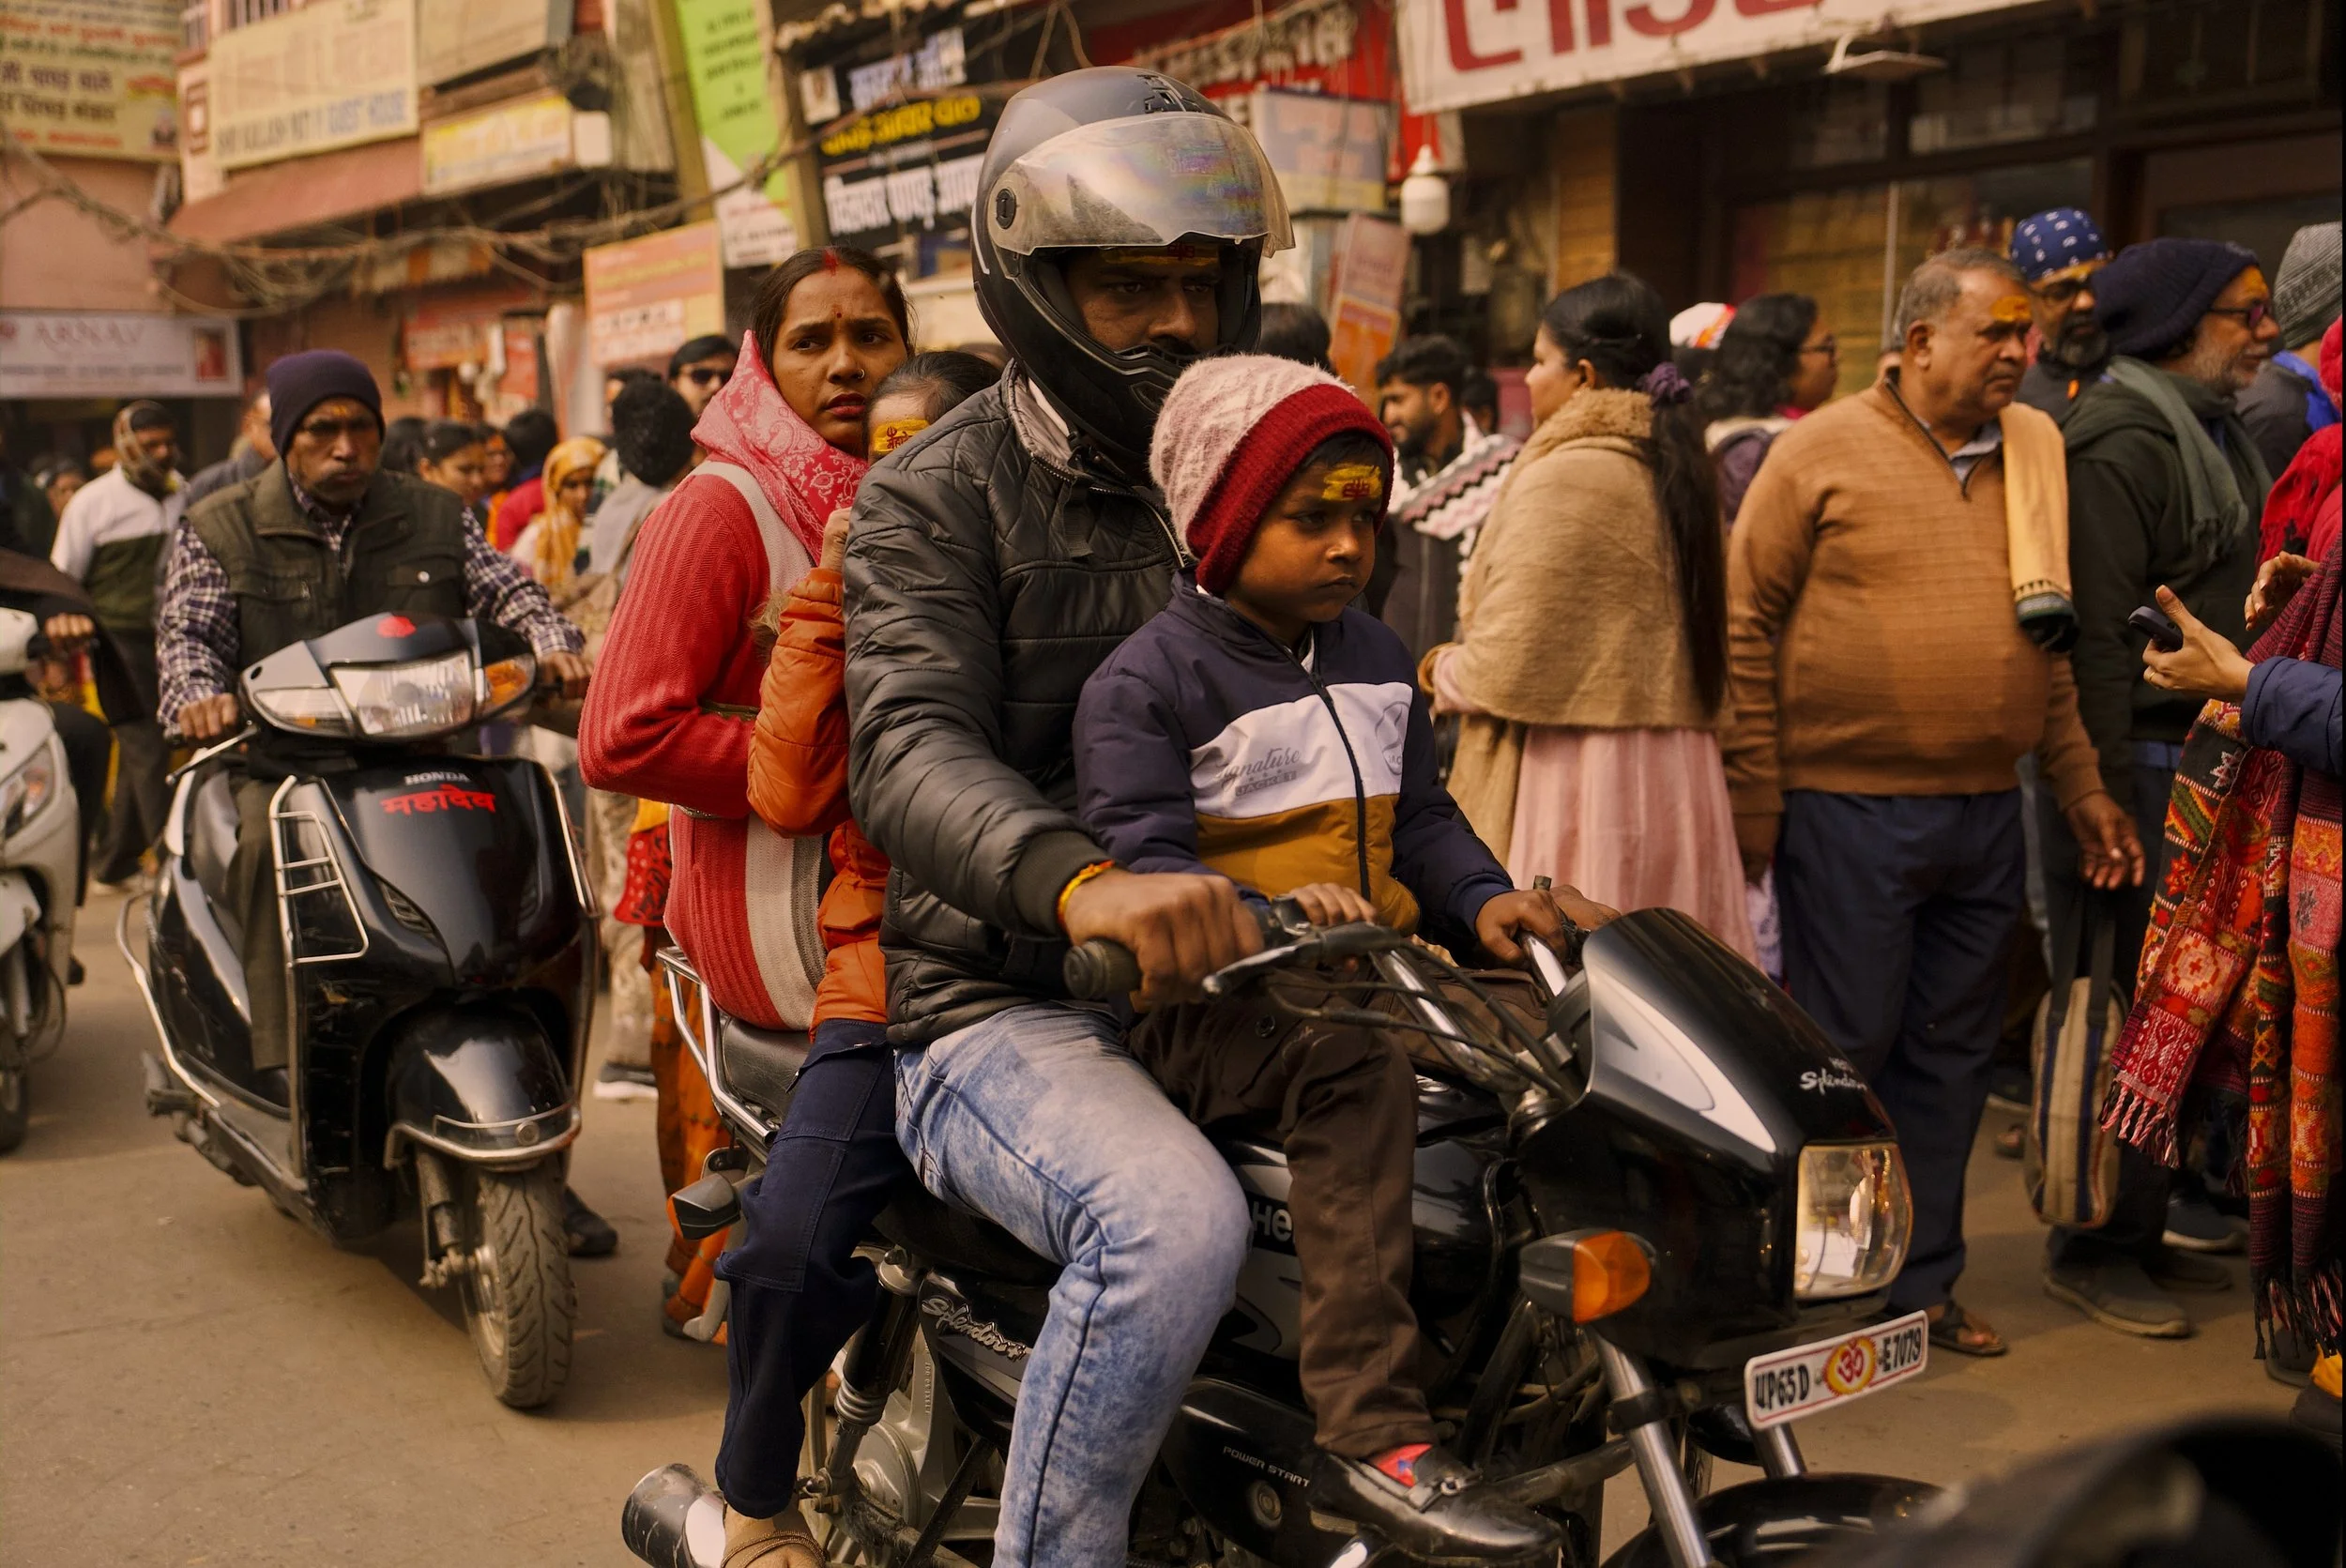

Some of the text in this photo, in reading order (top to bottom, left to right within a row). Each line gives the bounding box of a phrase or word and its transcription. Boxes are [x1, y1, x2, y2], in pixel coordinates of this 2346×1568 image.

[404, 771, 470, 785] HONDA
[380, 783, 496, 816] महादेव
[1223, 1445, 1310, 1487] POWER START
